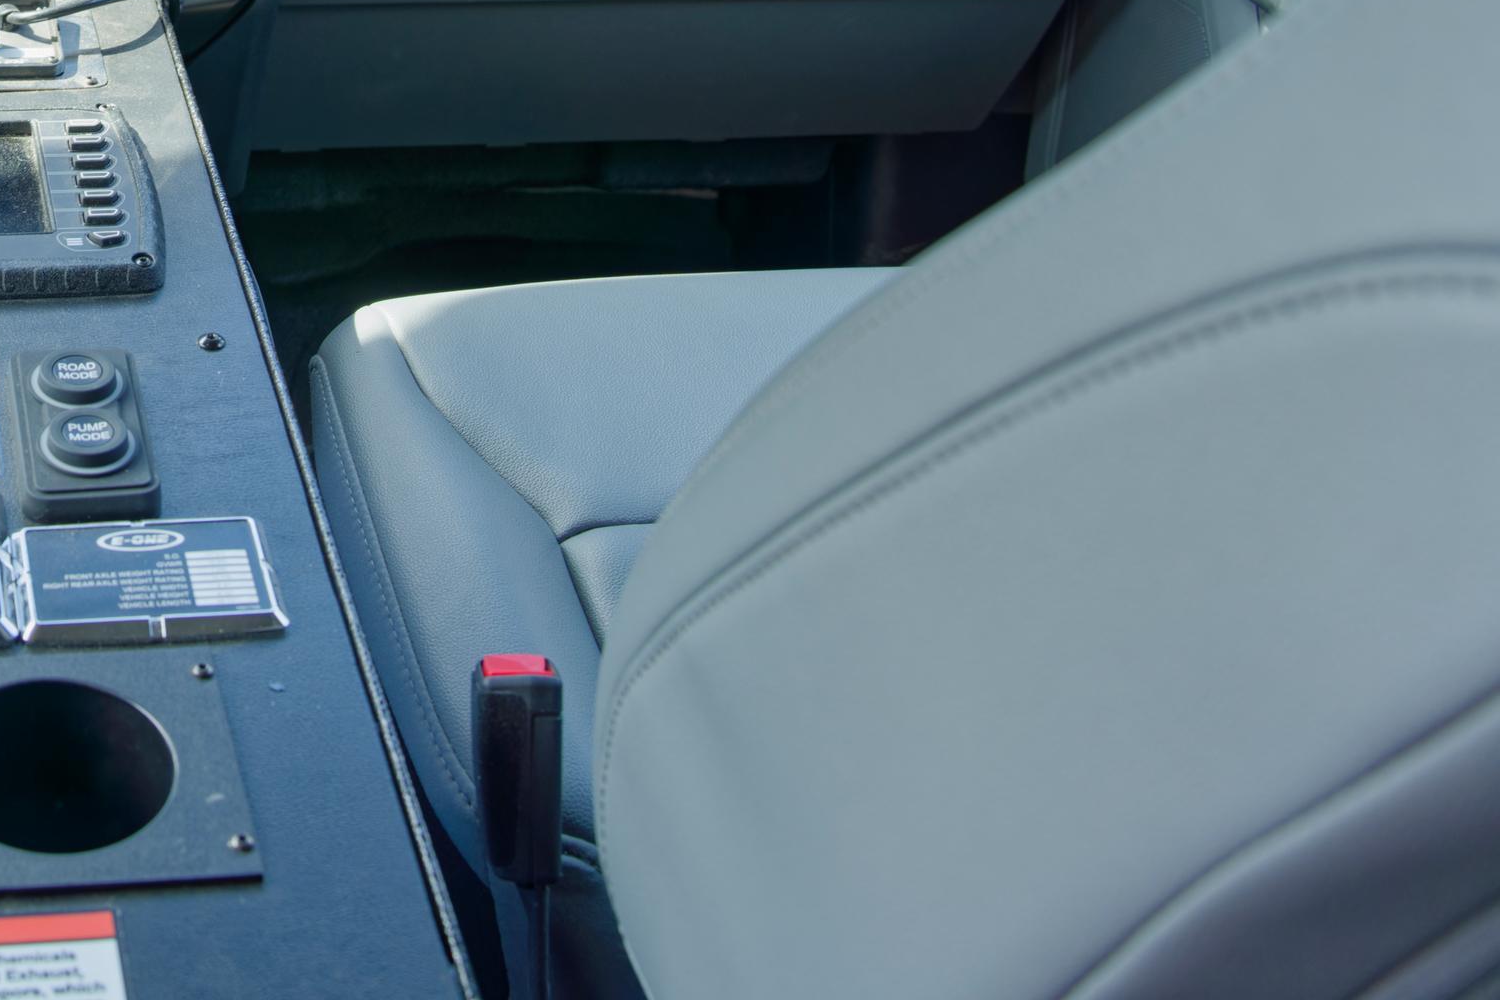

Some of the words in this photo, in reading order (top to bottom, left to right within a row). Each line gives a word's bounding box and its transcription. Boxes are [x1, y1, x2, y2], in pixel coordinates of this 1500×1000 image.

[57, 362, 97, 371] ROAD
[58, 370, 99, 380] MODE
[67, 421, 109, 432] PUMP
[68, 431, 111, 441] MODE
[109, 533, 171, 547] E-ONE
[63, 573, 93, 581] FRONT
[117, 570, 151, 579] WEIGHT
[152, 568, 185, 577] RATING
[70, 580, 94, 588] REAR
[94, 579, 118, 587] AXLE
[119, 577, 153, 586] WEIGHT
[154, 575, 187, 584] RATING
[121, 584, 157, 593] VEHICLE
[157, 583, 189, 591] WIDTH
[119, 592, 155, 601] VEHICLE
[155, 591, 190, 600] HEIGHT
[118, 601, 154, 609] VEHICLE
[154, 599, 192, 608] LENGTH
[5, 966, 84, 980] Exhaust,
[52, 981, 107, 995] which
